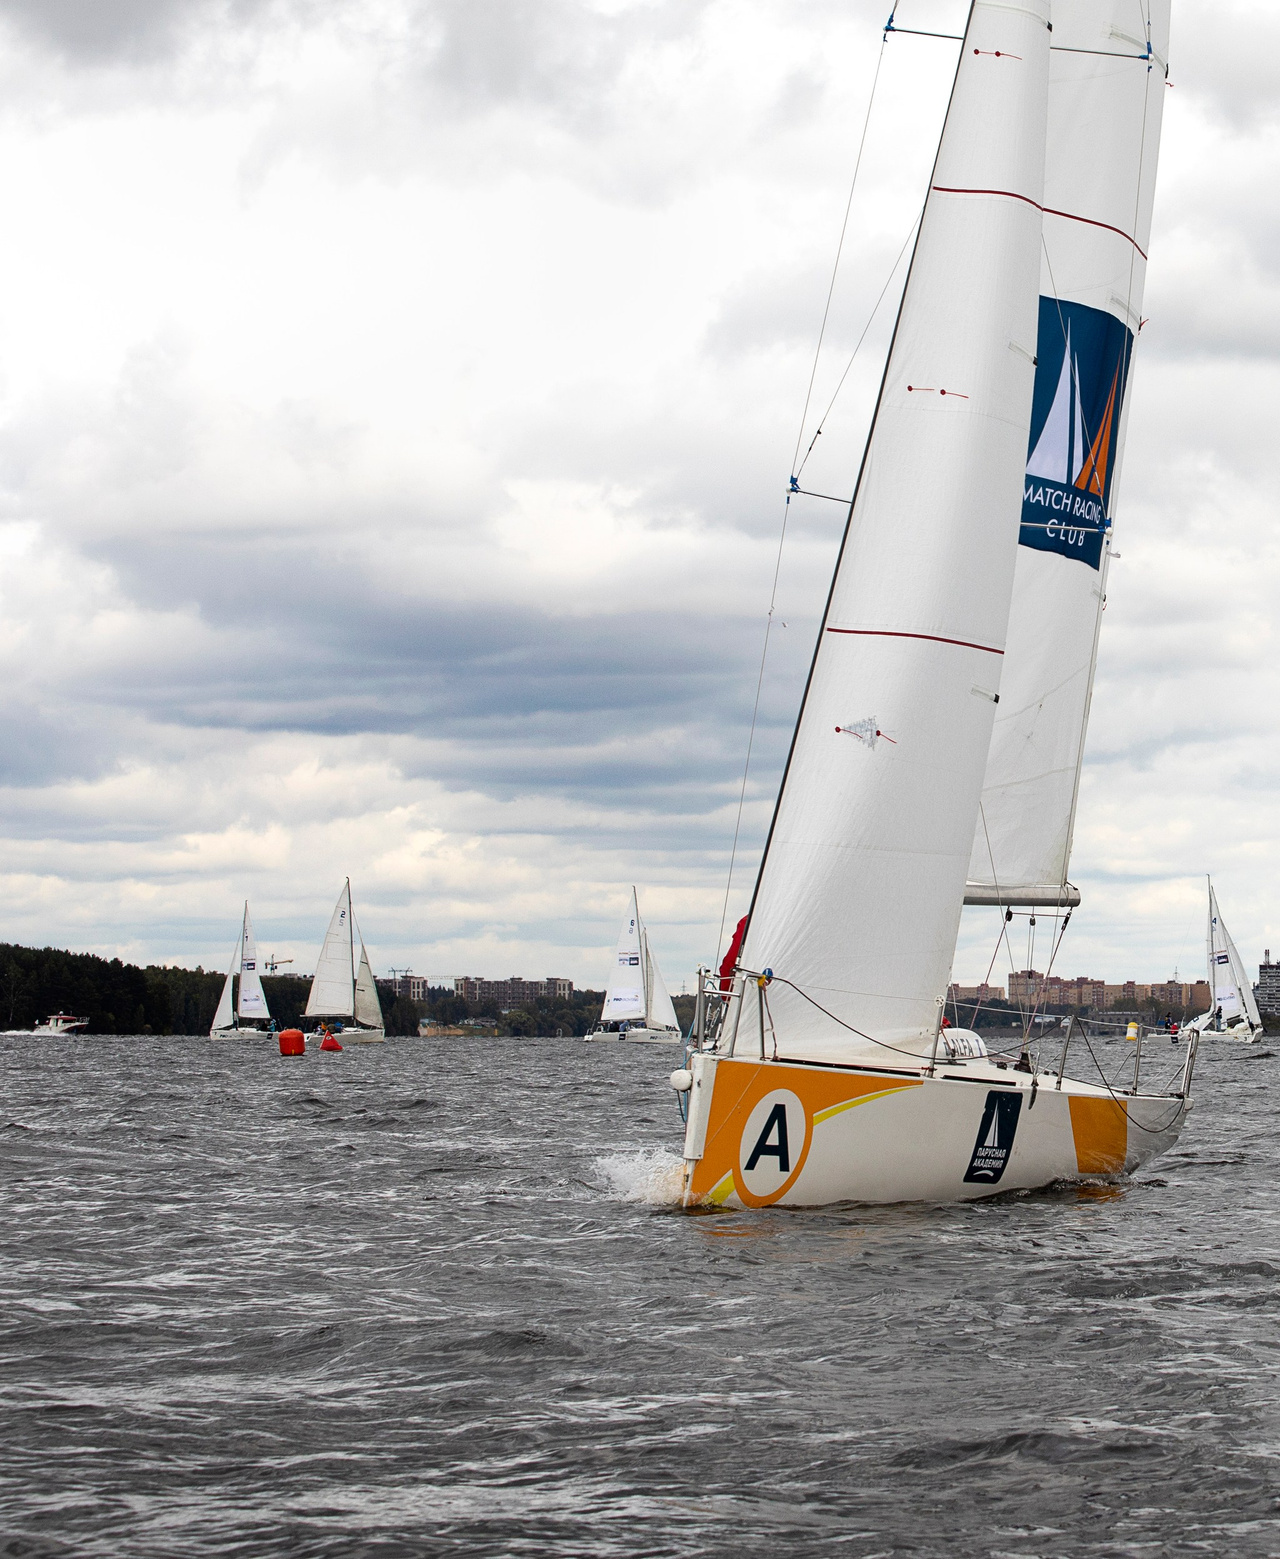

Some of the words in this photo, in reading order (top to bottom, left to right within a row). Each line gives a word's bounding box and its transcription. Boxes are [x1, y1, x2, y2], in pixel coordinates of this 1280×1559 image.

[1023, 484, 1073, 513] MATCH
[1073, 496, 1102, 525] RACING
[1046, 518, 1086, 547] CLUB
[743, 1103, 790, 1173] A
[972, 1158, 1004, 1169] АКАДЕМИЯ
[976, 1147, 1007, 1159] ПАРУСНАЯ
